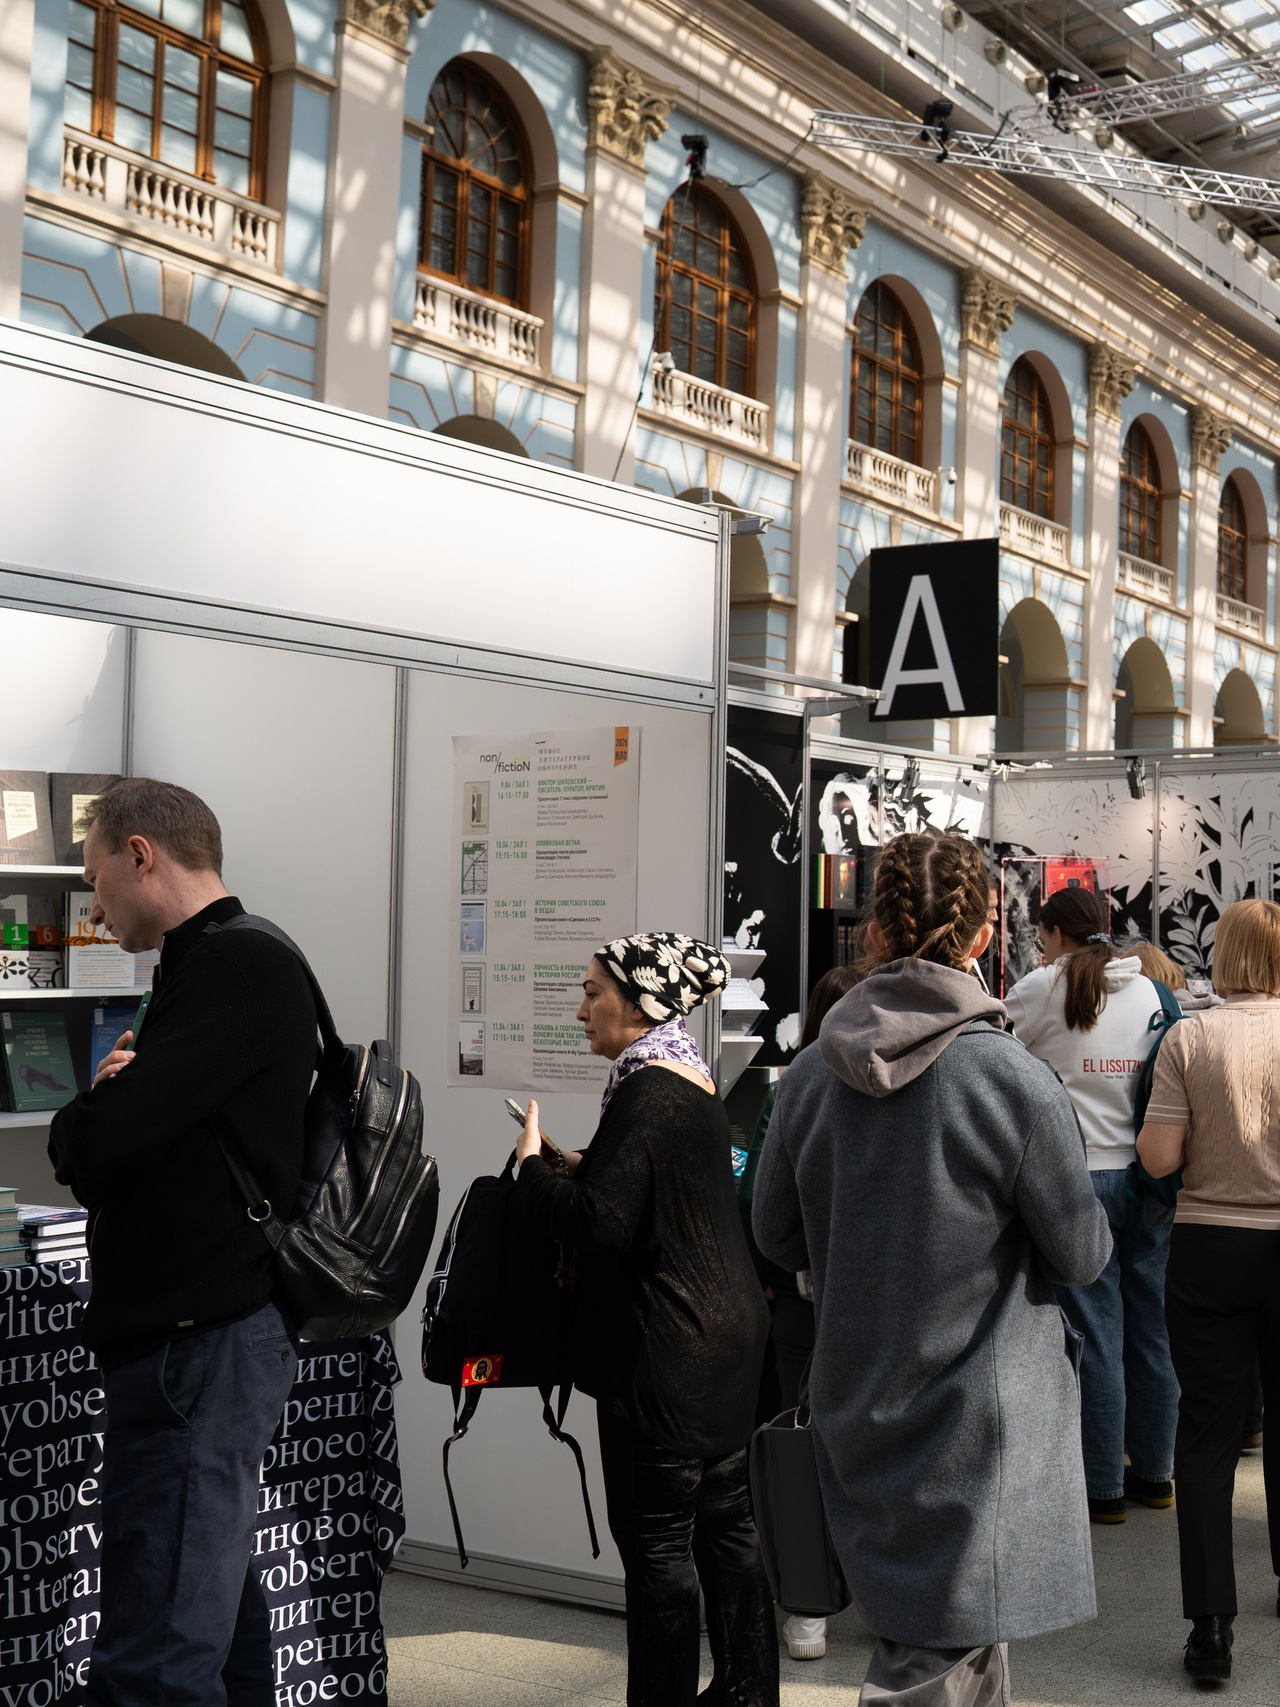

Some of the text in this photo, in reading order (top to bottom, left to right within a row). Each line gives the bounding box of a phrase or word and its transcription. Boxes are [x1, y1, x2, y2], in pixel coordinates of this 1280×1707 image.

[875, 575, 965, 716] A
[11, 925, 21, 941] 1
[43, 927, 53, 942] 6
[511, 963, 521, 971] ЗАЛ
[510, 1023, 520, 1031] ЗАЛ
[1083, 1059, 1145, 1073] EL LISSITZK
[294, 1351, 369, 1387] итер
